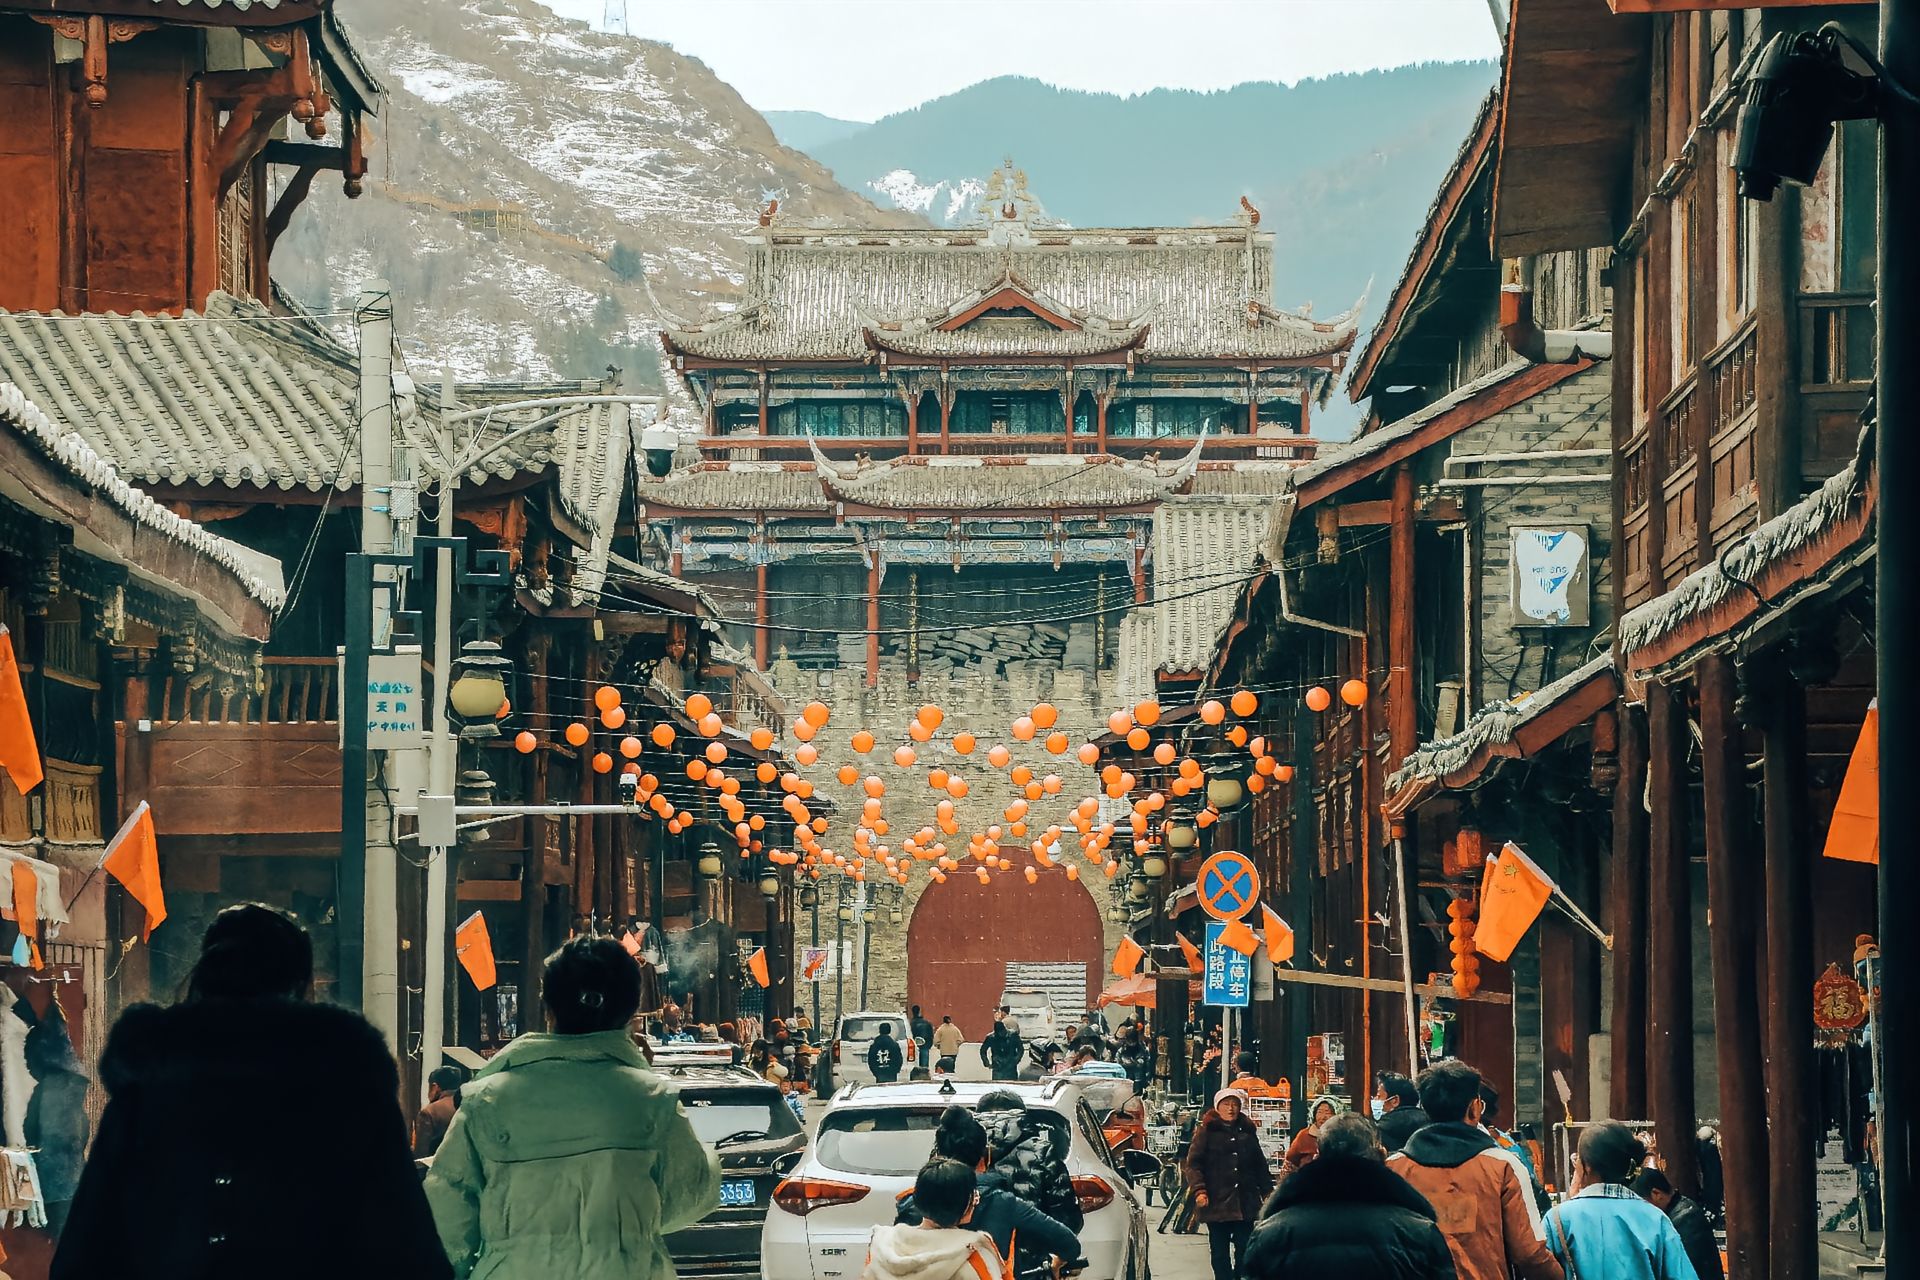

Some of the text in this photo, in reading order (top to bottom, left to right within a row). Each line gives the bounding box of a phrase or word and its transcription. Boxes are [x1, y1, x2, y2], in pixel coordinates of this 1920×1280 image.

[1208, 938, 1226, 990] 此路段
[1228, 949, 1247, 998] 止停车
[1820, 985, 1855, 1020] 福
